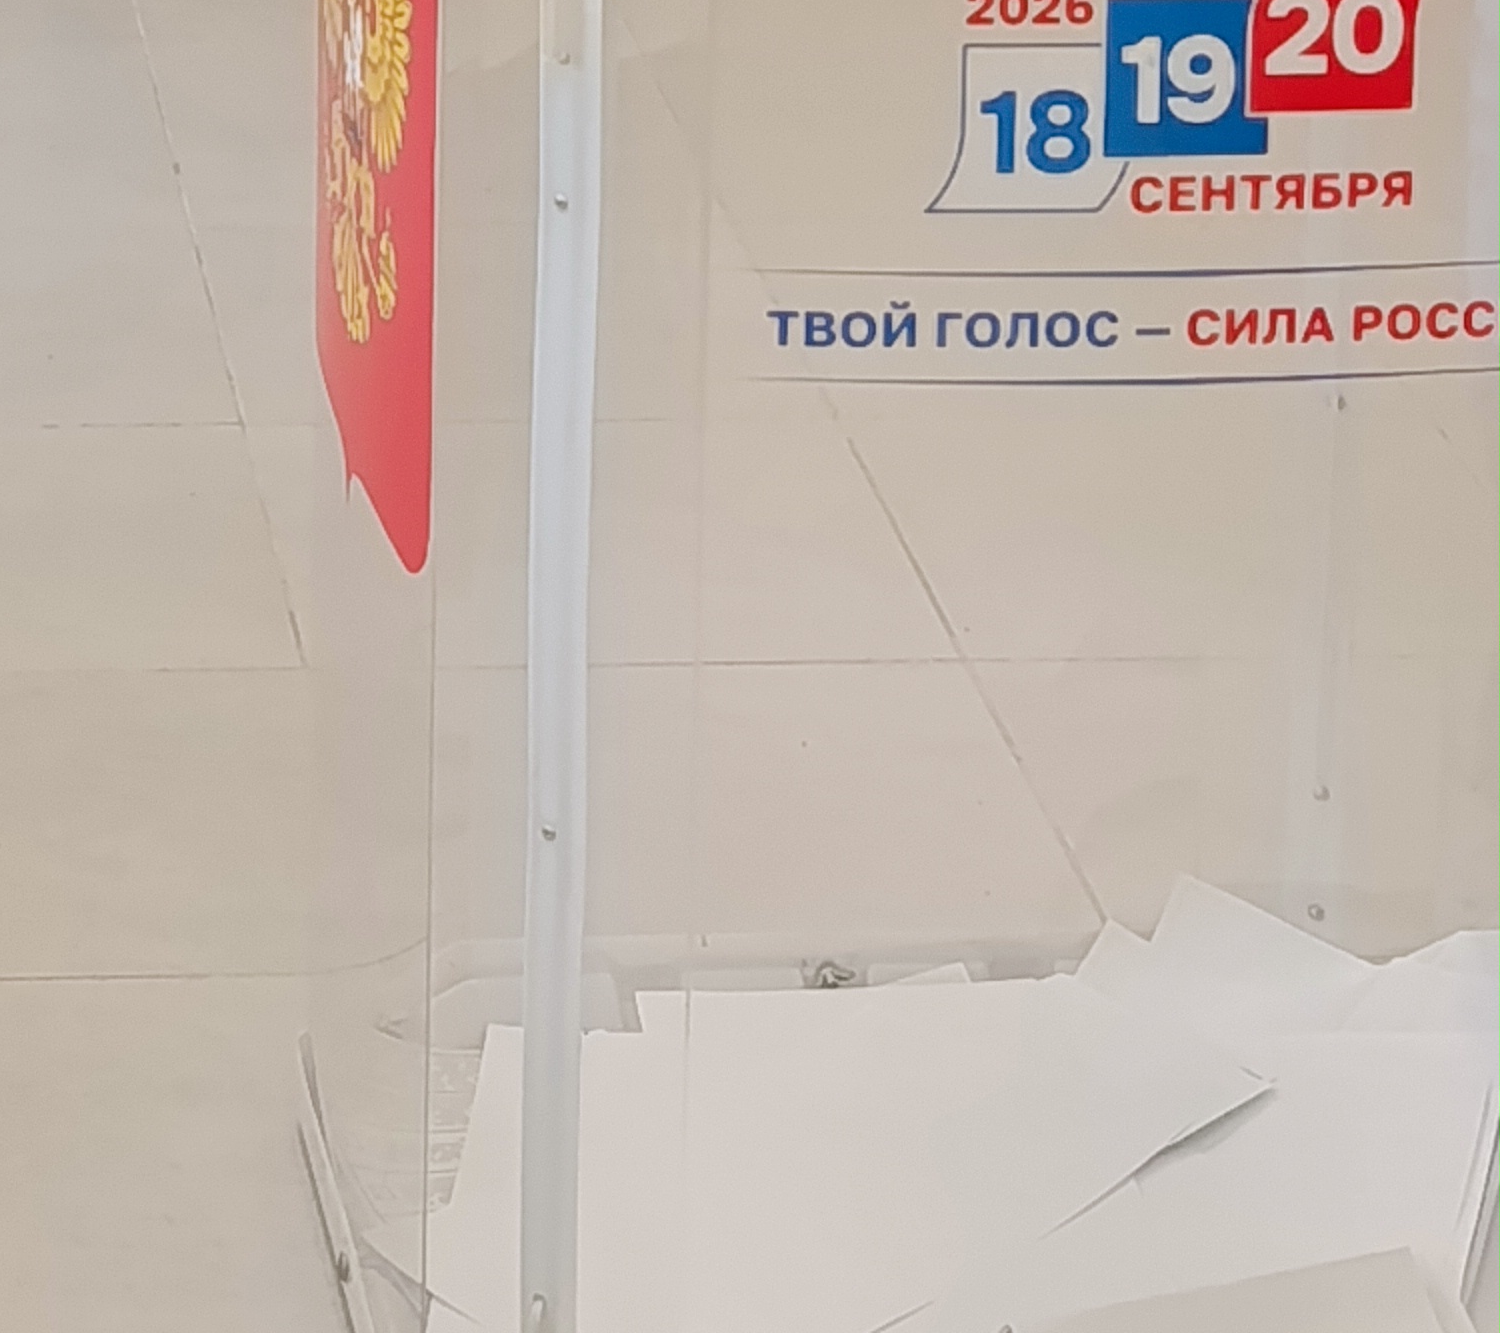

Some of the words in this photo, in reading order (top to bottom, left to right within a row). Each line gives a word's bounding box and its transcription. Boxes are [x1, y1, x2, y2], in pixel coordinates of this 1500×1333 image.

[979, 90, 1092, 175] 18
[1120, 34, 1236, 124] 19
[1129, 171, 1413, 215] СЕНТЯБРЯ
[766, 301, 917, 348] ТВОЙ
[936, 309, 1119, 349] ГОЛОС
[1186, 307, 1334, 348] СИЛА
[1352, 300, 1495, 341] РОСС
